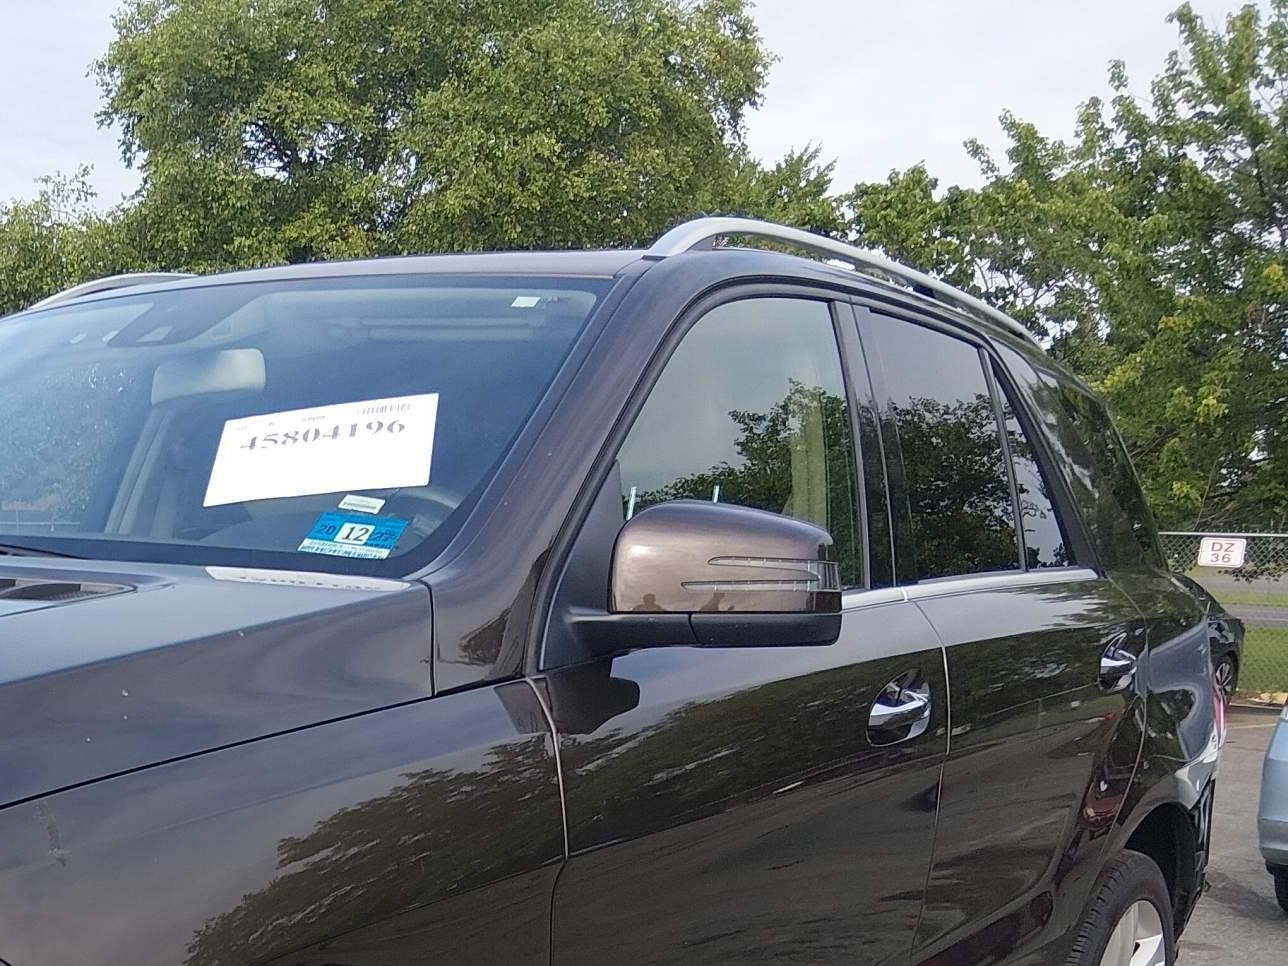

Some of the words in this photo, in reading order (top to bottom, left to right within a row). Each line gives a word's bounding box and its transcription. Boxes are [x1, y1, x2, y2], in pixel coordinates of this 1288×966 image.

[239, 418, 406, 451] 45804196
[341, 526, 370, 542] 12
[1211, 541, 1237, 553] DZ
[1210, 553, 1232, 563] 36
